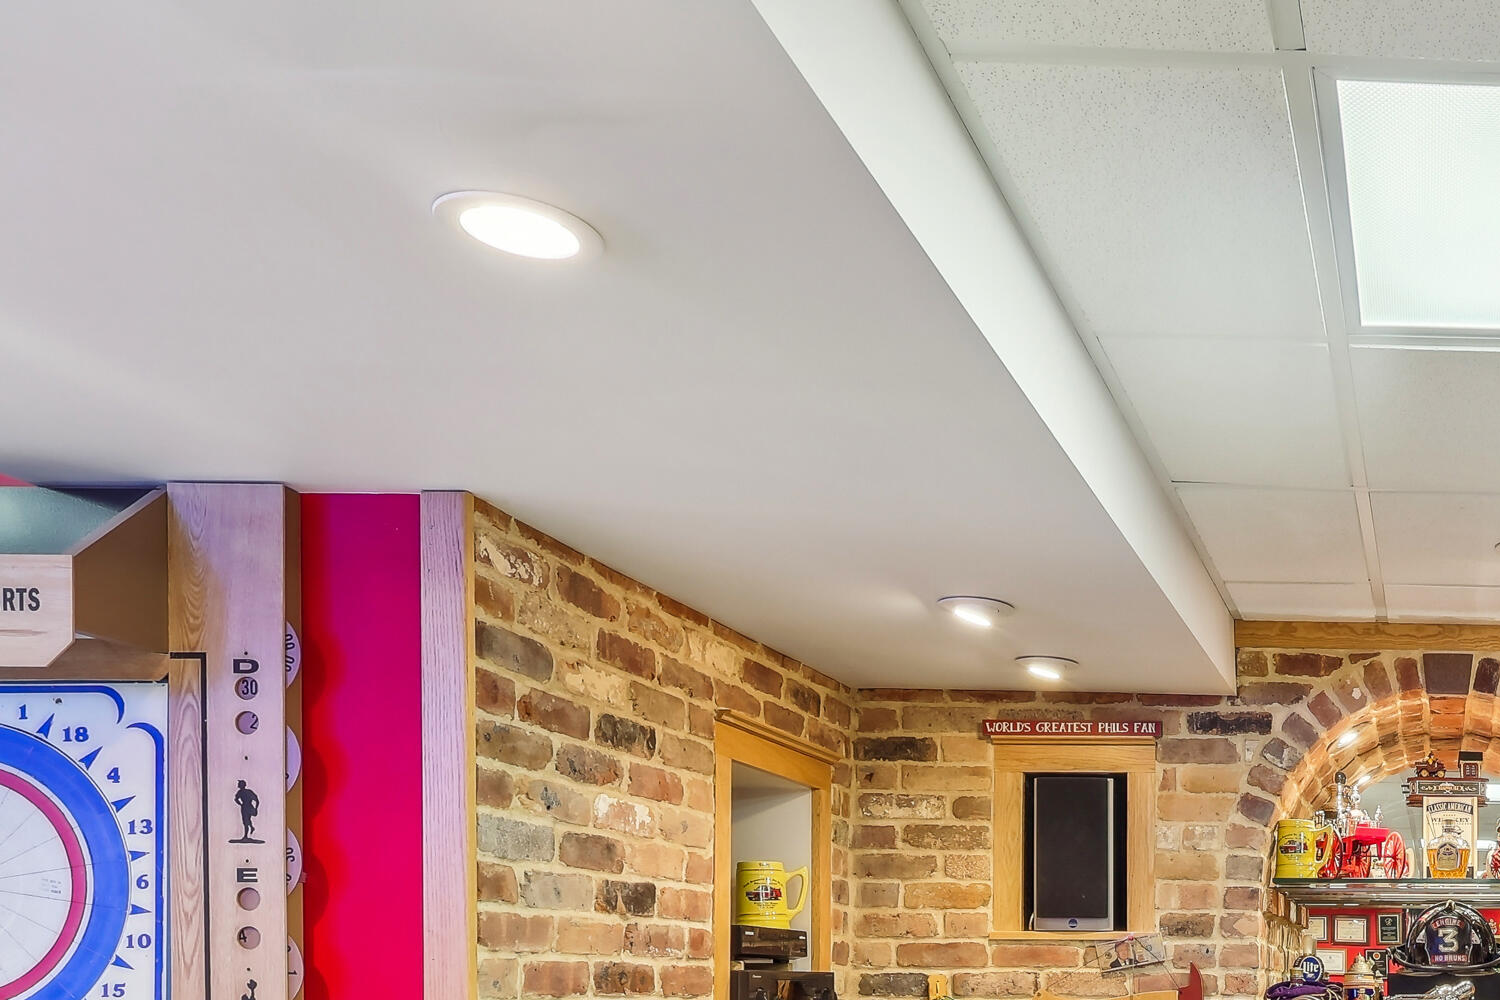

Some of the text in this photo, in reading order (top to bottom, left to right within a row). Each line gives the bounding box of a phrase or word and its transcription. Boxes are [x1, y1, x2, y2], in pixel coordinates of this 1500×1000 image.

[233, 659, 259, 673] D
[241, 680, 258, 695] 30
[18, 704, 28, 720] 1
[250, 714, 259, 729] 2
[1035, 722, 1093, 733] GREATEST
[1098, 722, 1129, 733] PHILS
[1134, 722, 1156, 733] FAN
[62, 727, 89, 743] 18
[106, 767, 121, 783] 4
[1428, 802, 1473, 814] CLASSIC AMERICAN
[127, 819, 153, 835] 13
[136, 875, 149, 889] 6
[236, 868, 258, 882] E
[1433, 917, 1464, 928] ENGINE
[126, 934, 151, 949] 10
[1438, 928, 1459, 952] 3
[1302, 961, 1319, 974] Lite
[101, 983, 126, 998] 15
